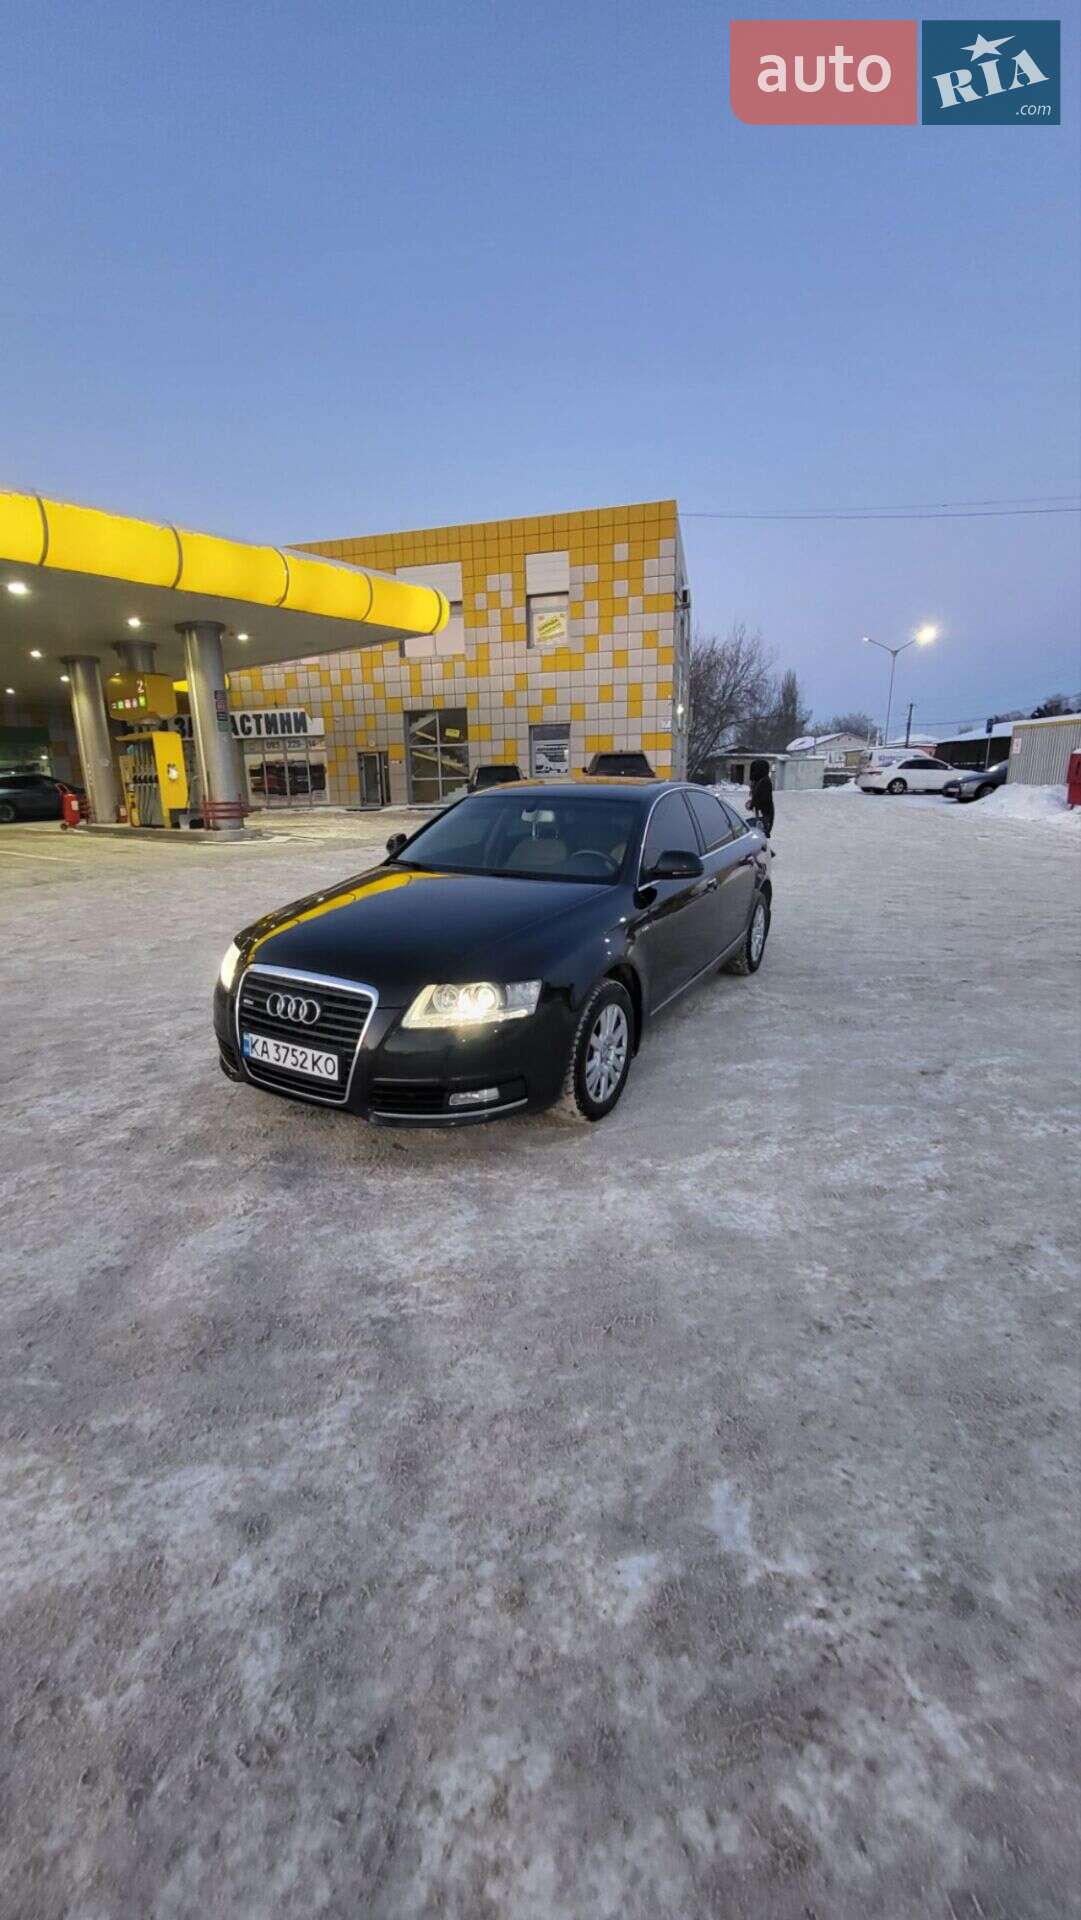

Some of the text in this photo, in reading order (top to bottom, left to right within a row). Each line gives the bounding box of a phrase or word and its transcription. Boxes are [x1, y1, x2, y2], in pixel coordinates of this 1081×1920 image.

[136, 680, 145, 693] 2
[250, 1037, 336, 1076] KA 3752 KO
